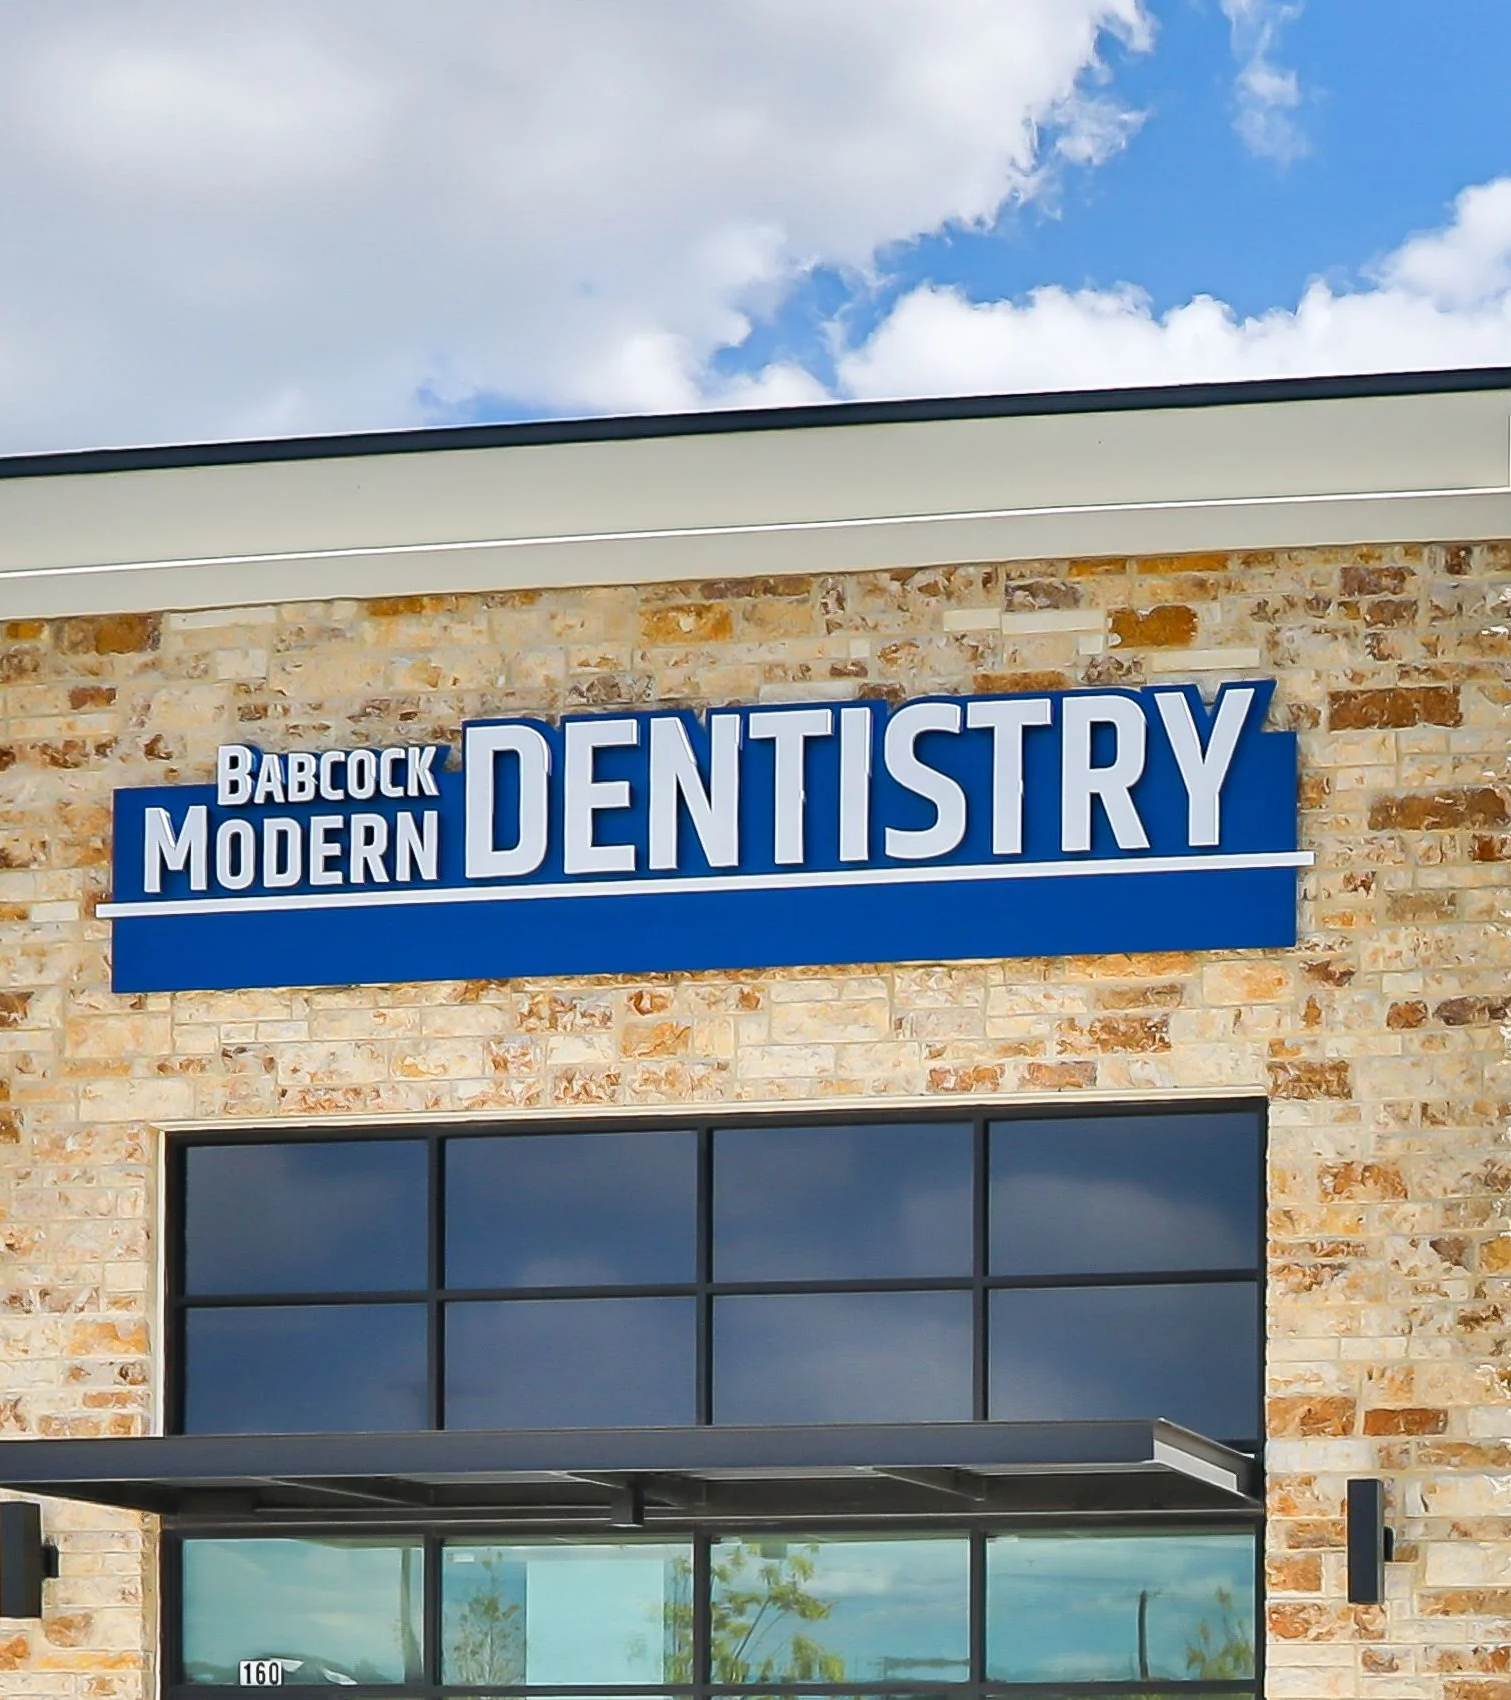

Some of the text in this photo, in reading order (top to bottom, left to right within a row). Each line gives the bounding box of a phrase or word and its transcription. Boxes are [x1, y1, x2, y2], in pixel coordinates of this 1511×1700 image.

[144, 687, 1256, 893] MODERN DENTISTRY
[217, 744, 439, 806] BABCOCK
[243, 1661, 279, 1685] 160
